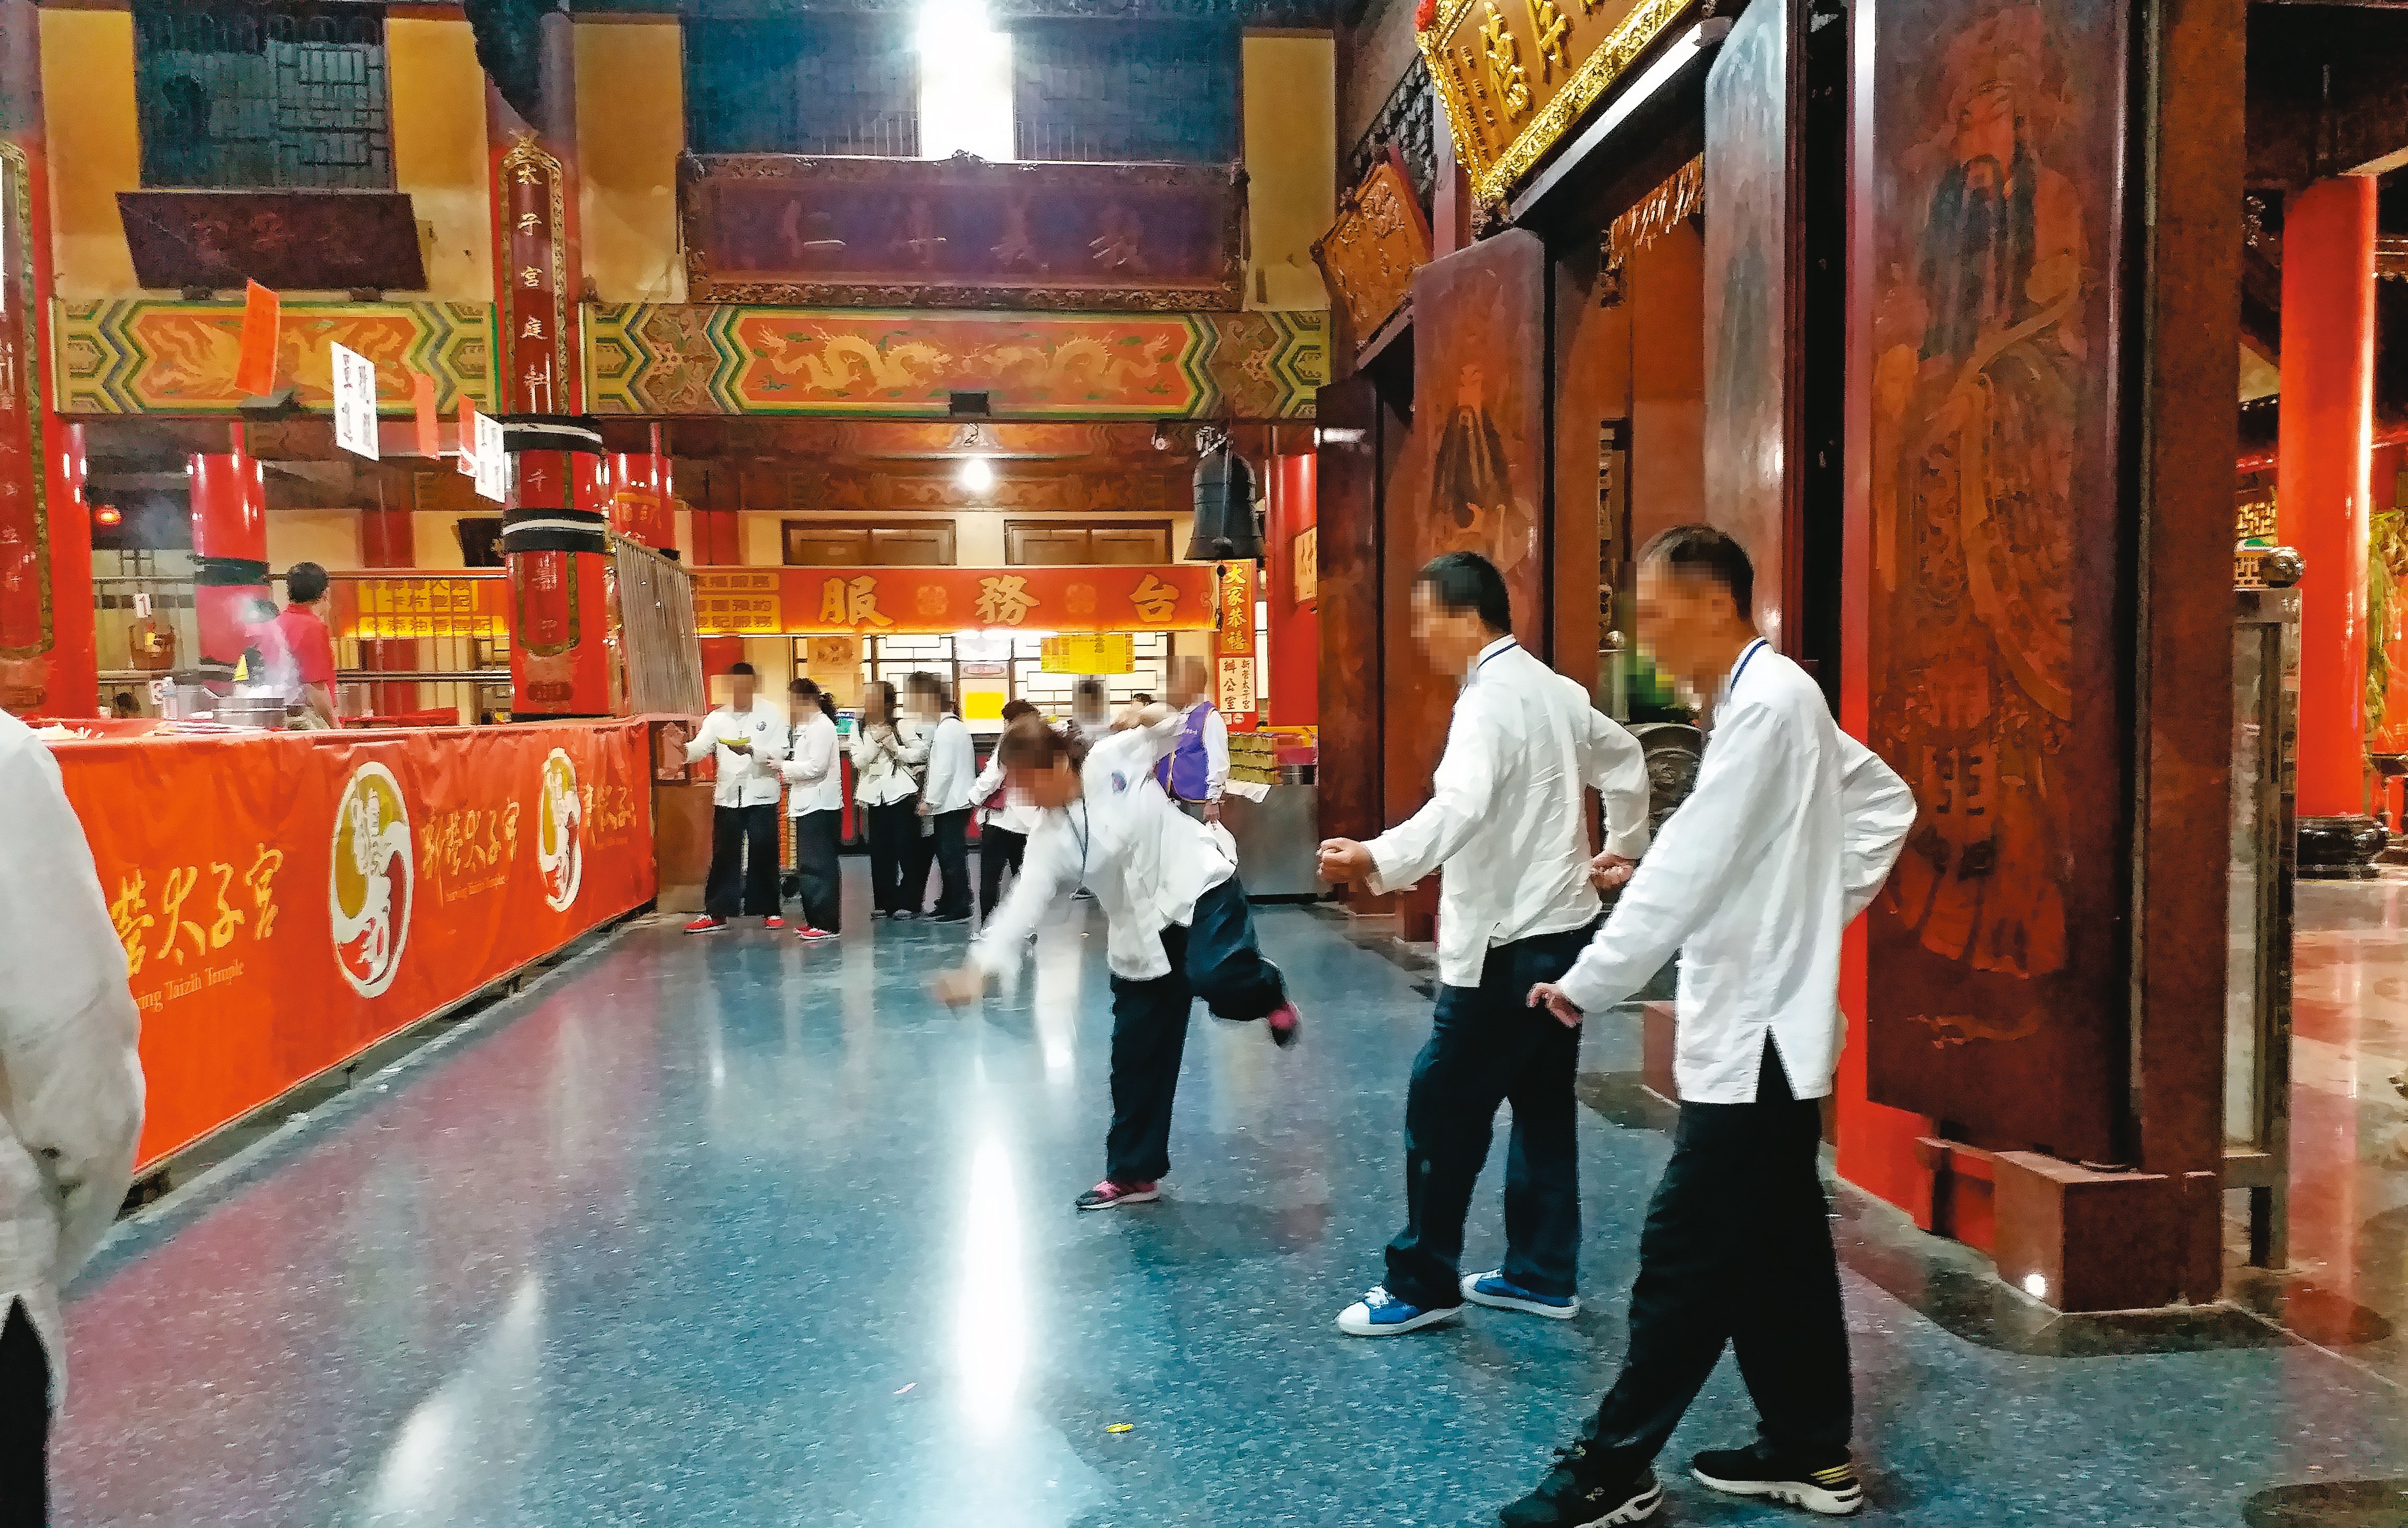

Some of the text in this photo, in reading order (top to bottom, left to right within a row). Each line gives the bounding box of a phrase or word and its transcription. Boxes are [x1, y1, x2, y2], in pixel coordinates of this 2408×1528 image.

[818, 573, 1180, 627] 服務台
[1223, 563, 1248, 650] 大家恭禧
[1241, 659, 1251, 710] 新營太子宮
[204, 958, 245, 987] Temple
